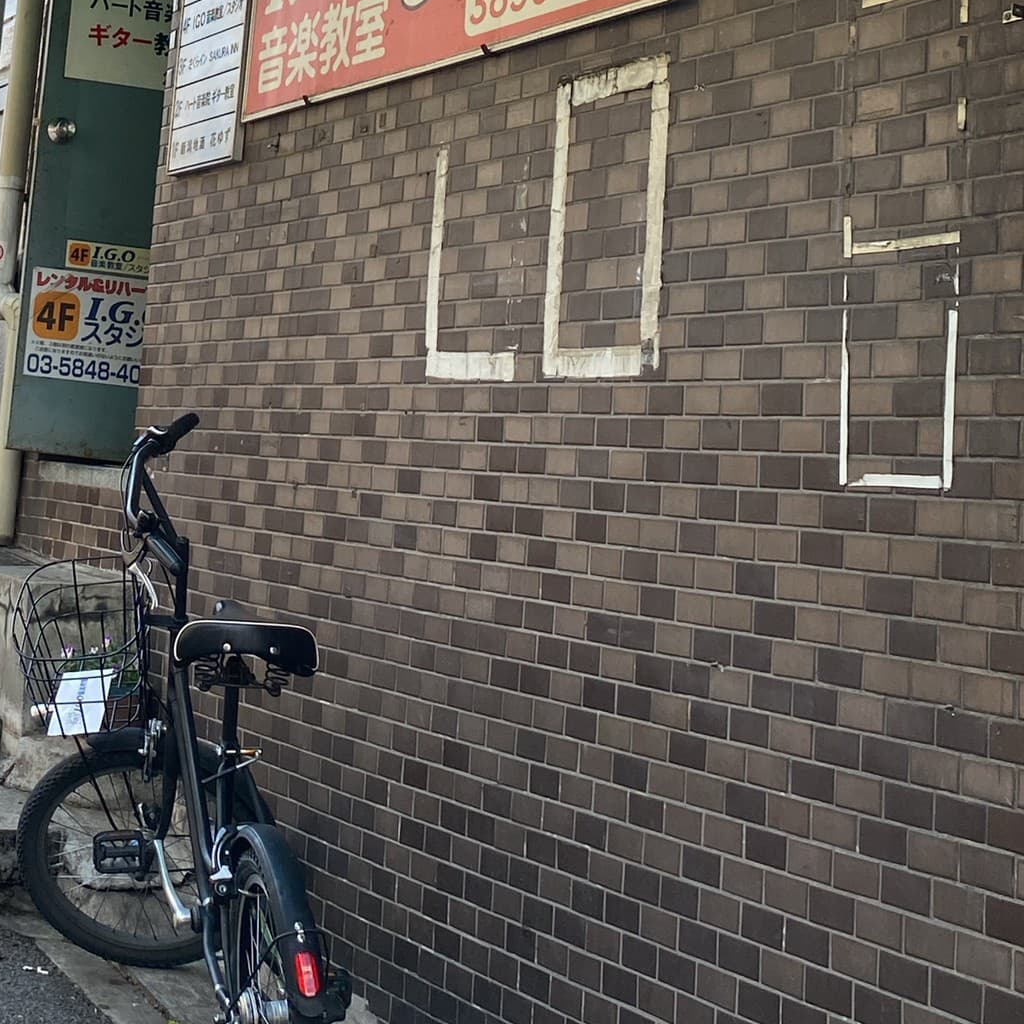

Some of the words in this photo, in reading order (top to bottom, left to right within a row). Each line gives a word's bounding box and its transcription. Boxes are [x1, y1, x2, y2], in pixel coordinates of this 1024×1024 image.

[70, 247, 89, 263] 4F
[92, 246, 136, 263] I.G.O
[36, 301, 76, 333] 4F
[84, 296, 145, 327] I.G.
[27, 353, 141, 384] 03-5848-40
